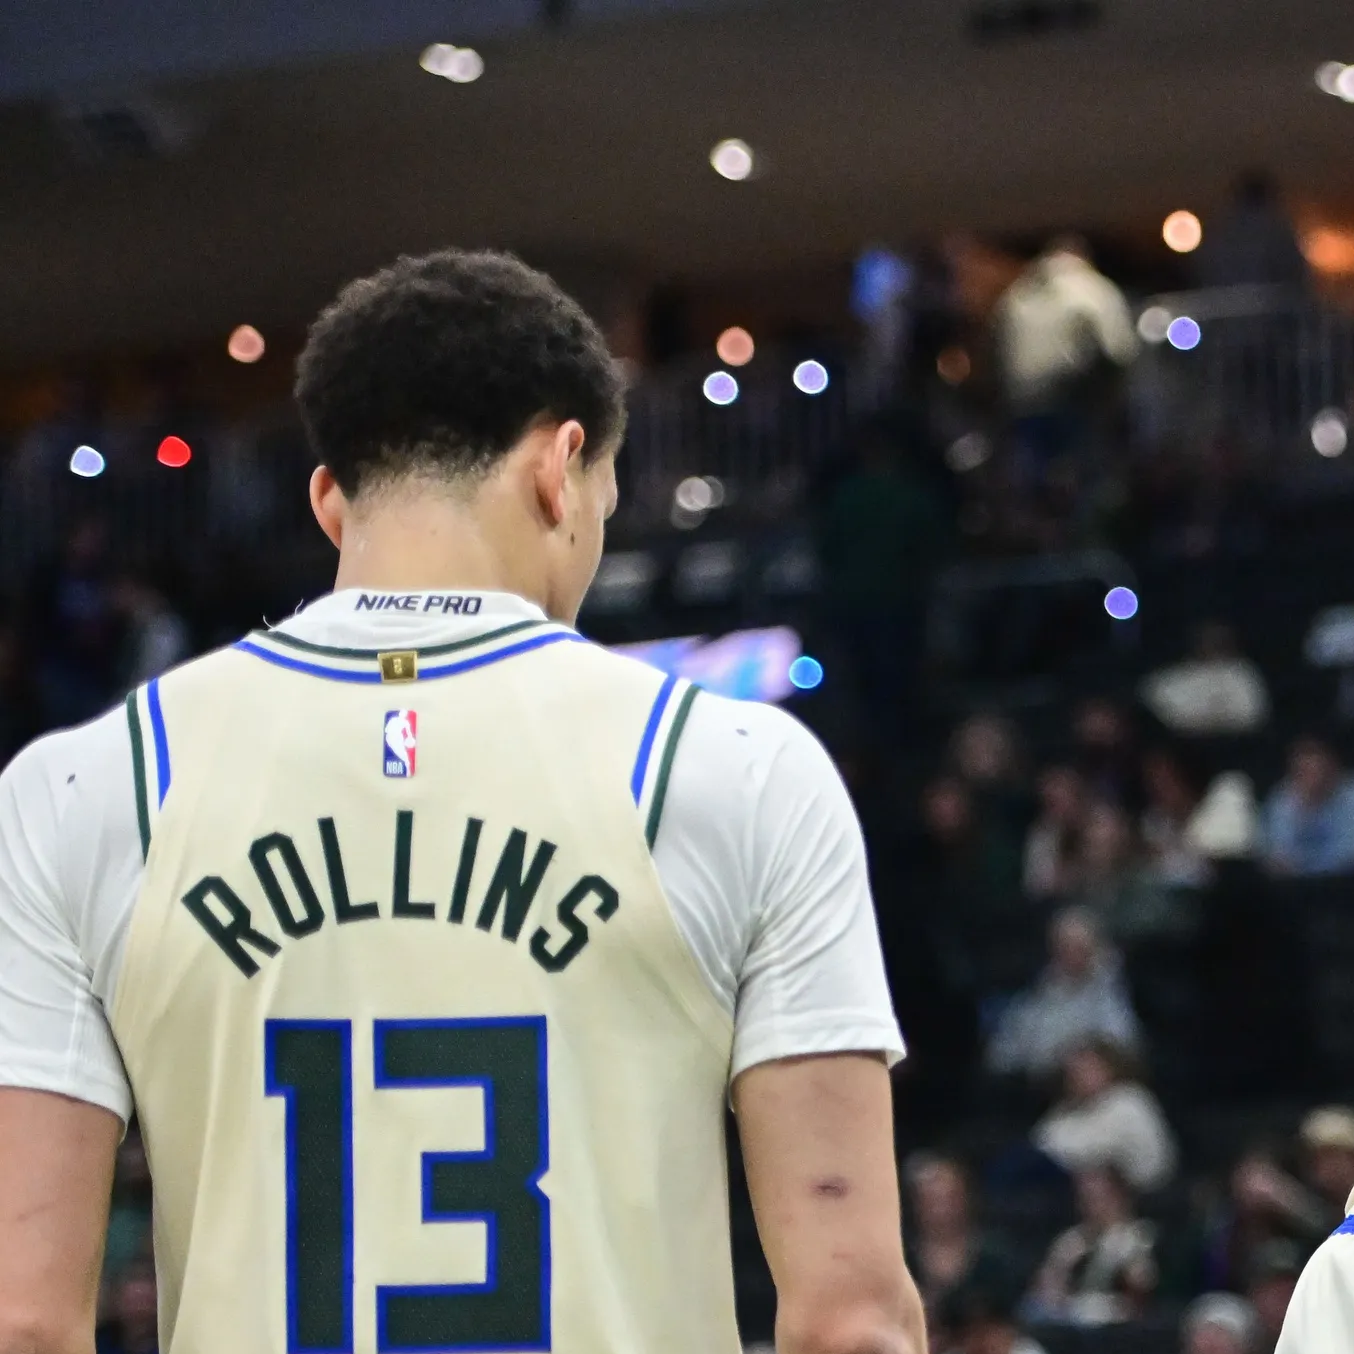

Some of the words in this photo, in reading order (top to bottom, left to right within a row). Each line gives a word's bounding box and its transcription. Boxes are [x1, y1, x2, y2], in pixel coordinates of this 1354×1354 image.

[355, 594, 422, 611] NIKE
[423, 594, 482, 616] PRO
[386, 760, 404, 775] NBA
[181, 810, 619, 979] ROLLINS
